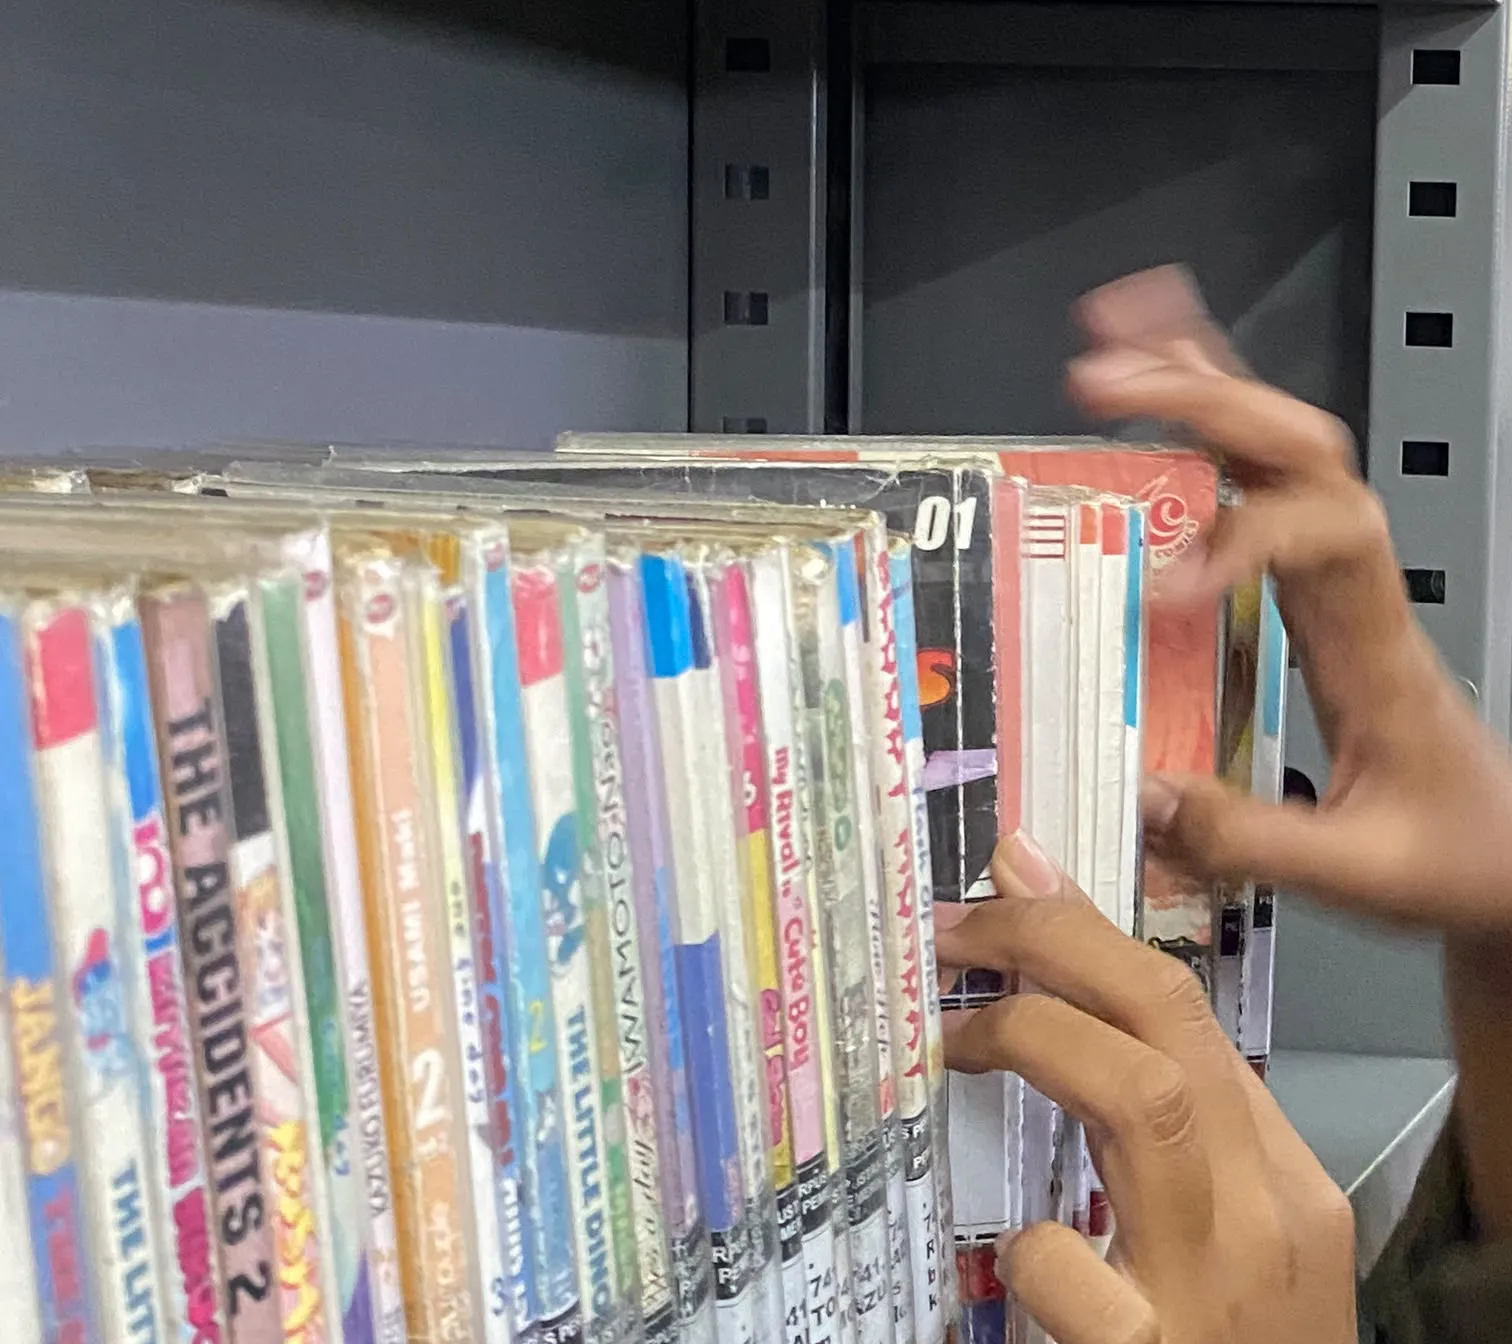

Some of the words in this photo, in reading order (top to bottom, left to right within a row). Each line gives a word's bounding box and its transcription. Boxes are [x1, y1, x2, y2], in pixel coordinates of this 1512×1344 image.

[913, 495, 978, 553] 01
[168, 698, 222, 836] THE
[770, 746, 792, 786] my
[776, 791, 800, 876] Rival
[606, 834, 644, 1076] IWAMOTO
[784, 916, 806, 992] Cute
[181, 864, 265, 1246] ACCIDENTS
[565, 1003, 591, 1086] THE
[788, 994, 811, 1073] Boy
[412, 1047, 447, 1132] 2
[573, 1088, 602, 1209] LITTLE
[108, 1159, 148, 1248] THE
[227, 1262, 270, 1316] 2
